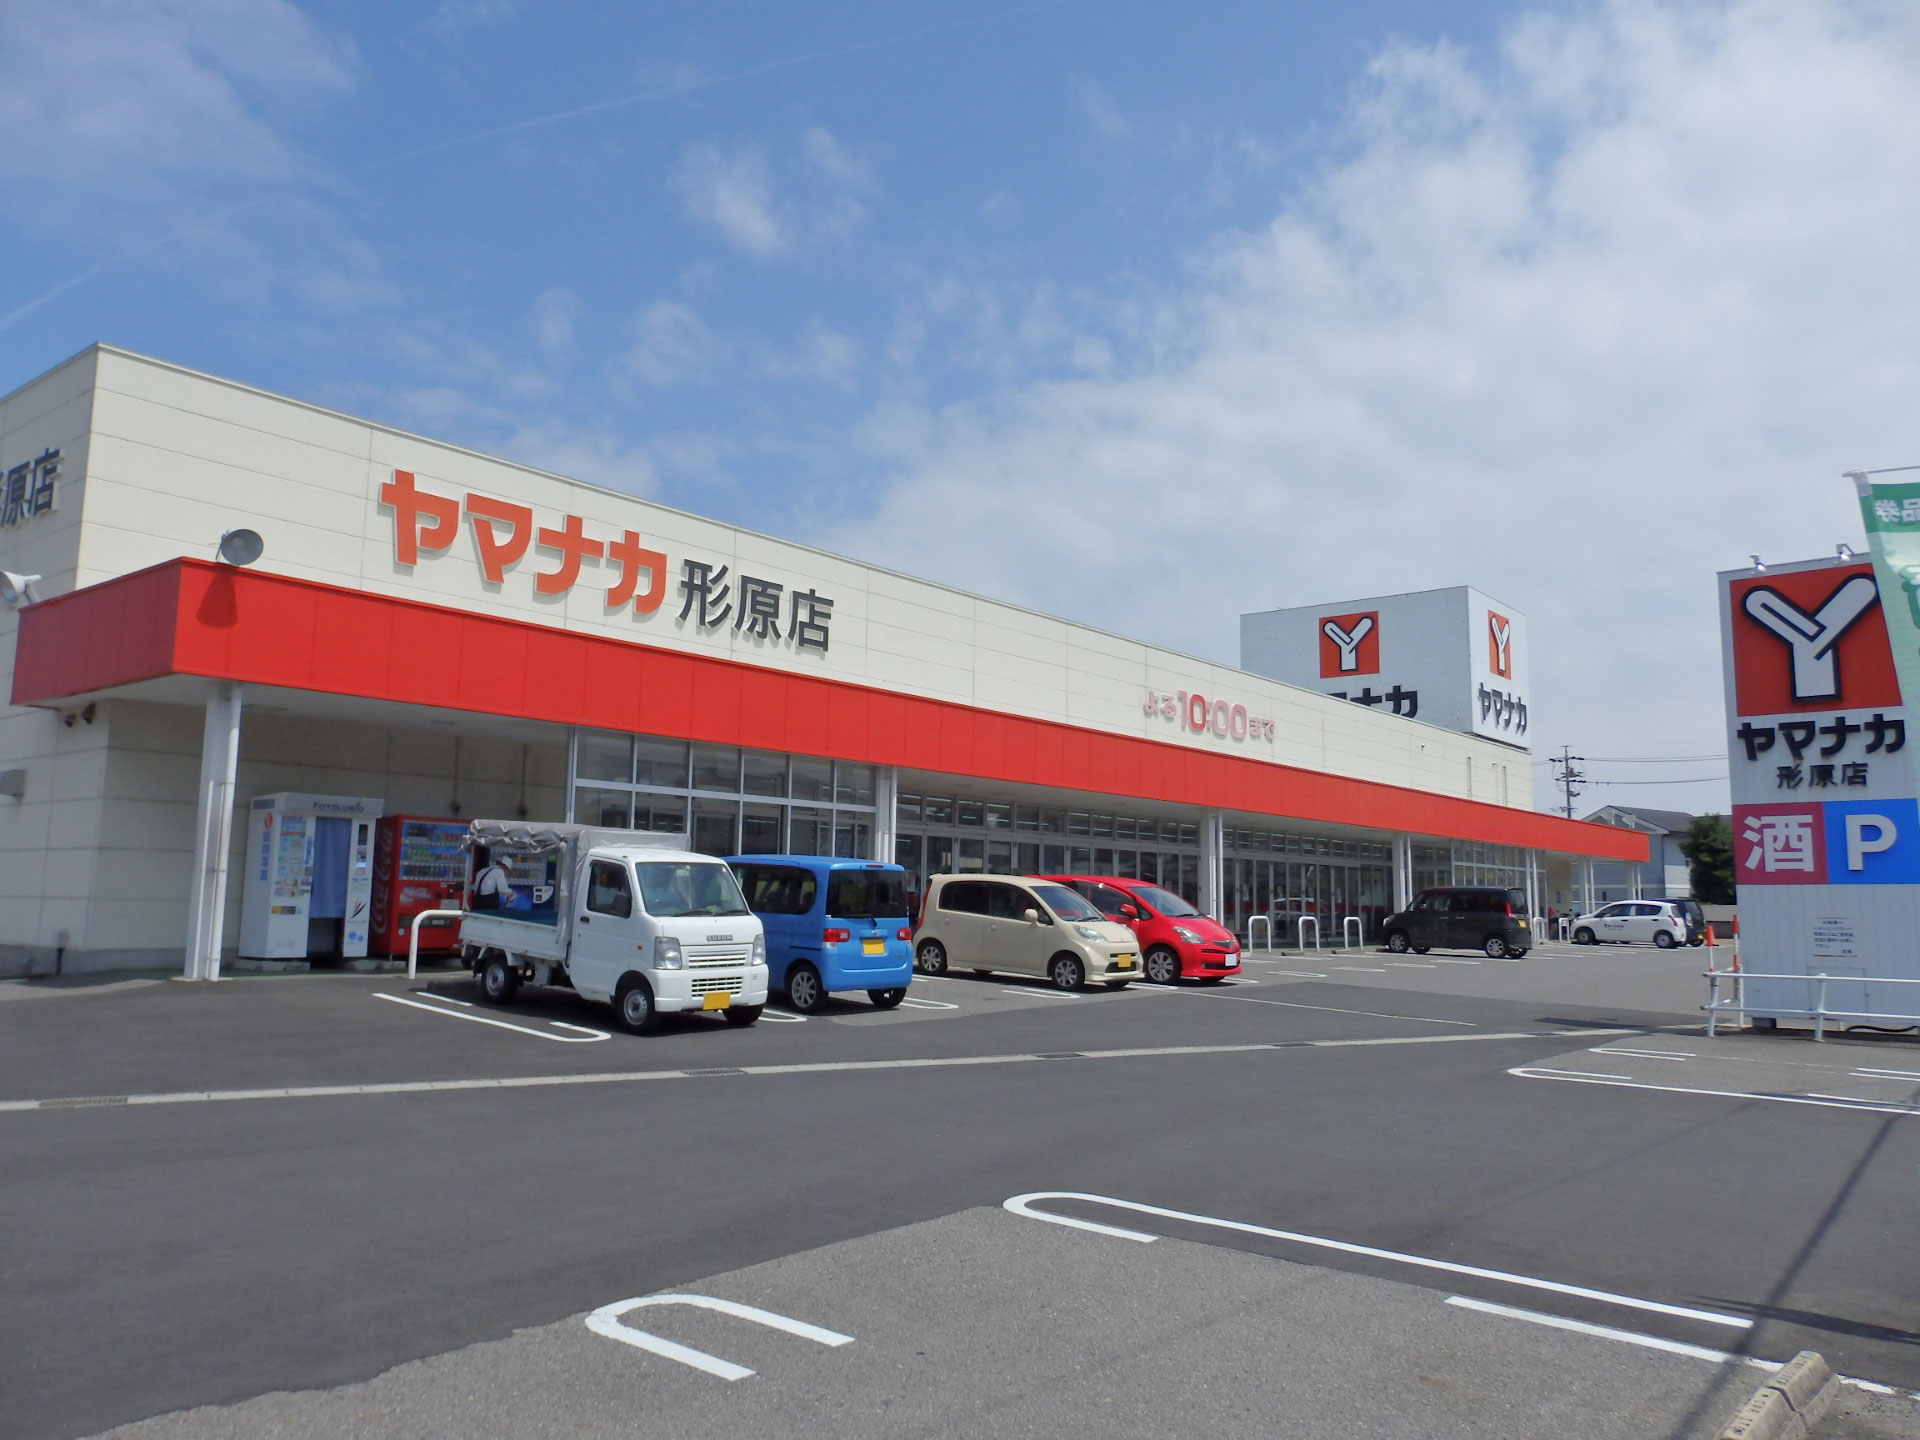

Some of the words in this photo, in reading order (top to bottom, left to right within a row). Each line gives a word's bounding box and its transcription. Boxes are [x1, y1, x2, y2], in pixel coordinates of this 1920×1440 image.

[0, 448, 61, 528] 原店
[380, 468, 667, 614] ヤマナカ
[678, 559, 834, 652] 形原店
[1478, 682, 1527, 735] ヤマナカ
[1737, 713, 1906, 761] ヤマナカ
[1777, 761, 1869, 789] 形原店
[1743, 814, 1815, 873] 酒
[1845, 813, 1898, 871] P
